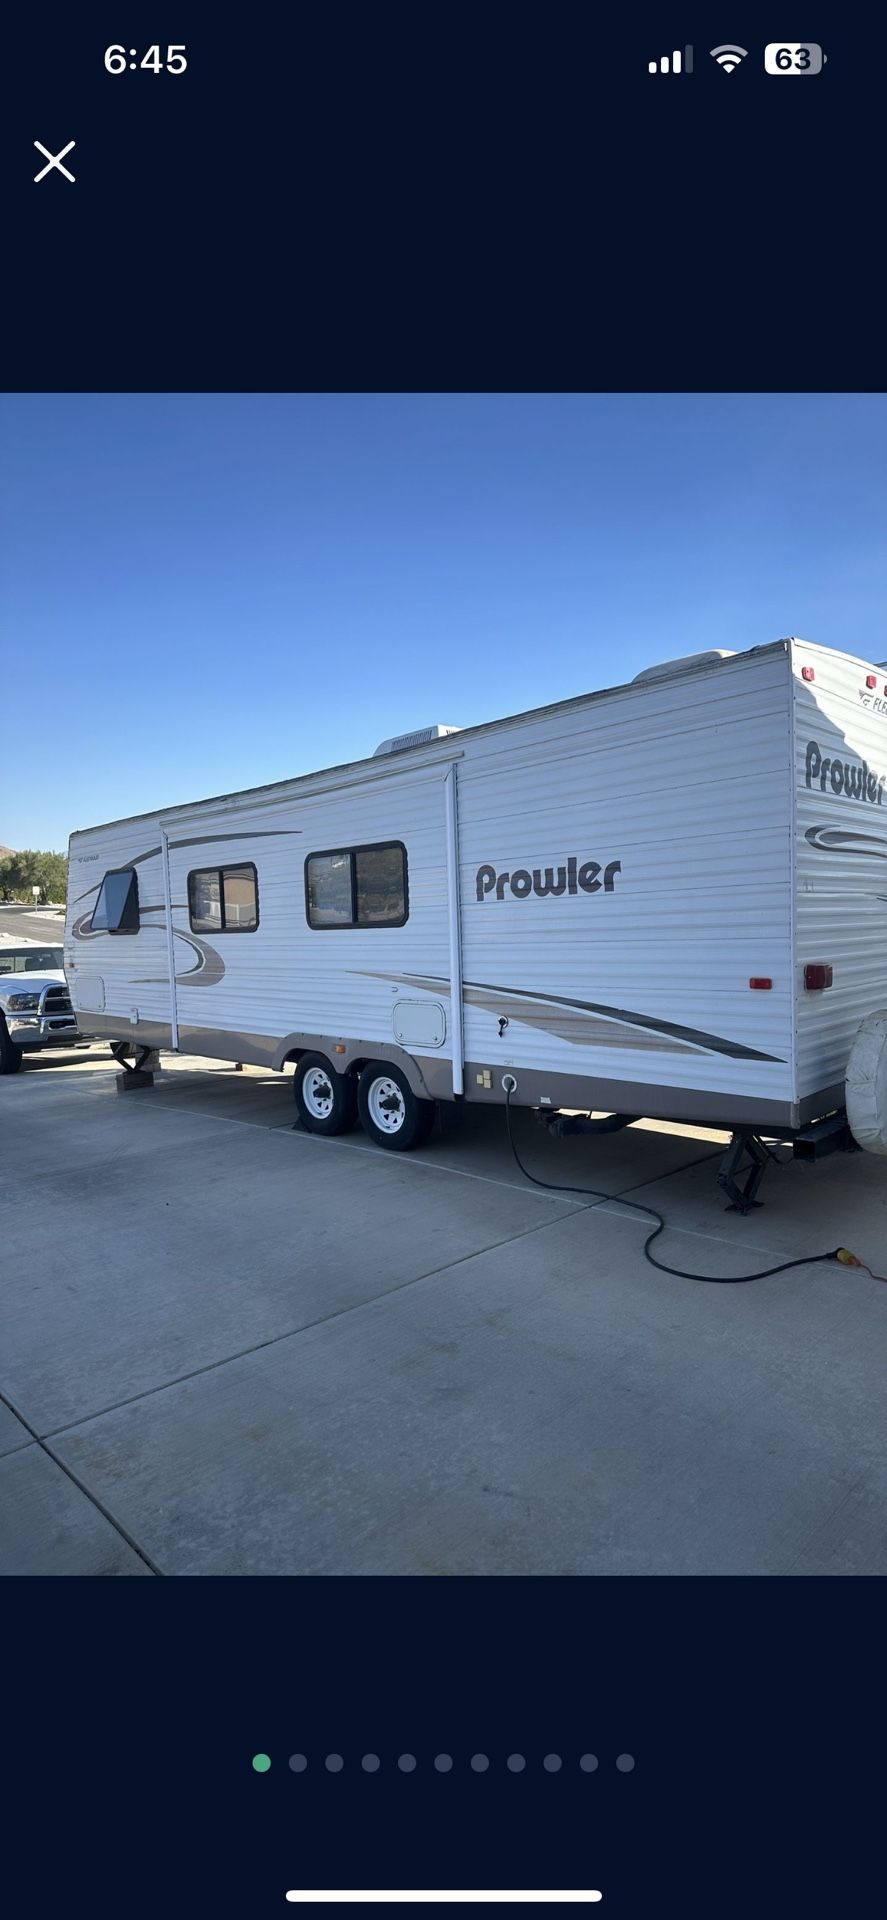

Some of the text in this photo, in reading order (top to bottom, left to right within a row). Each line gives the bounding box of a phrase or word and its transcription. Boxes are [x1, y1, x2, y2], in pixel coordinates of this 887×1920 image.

[873, 697, 887, 716] FLE
[805, 740, 887, 806] Prowler
[475, 856, 622, 903] Prowler
